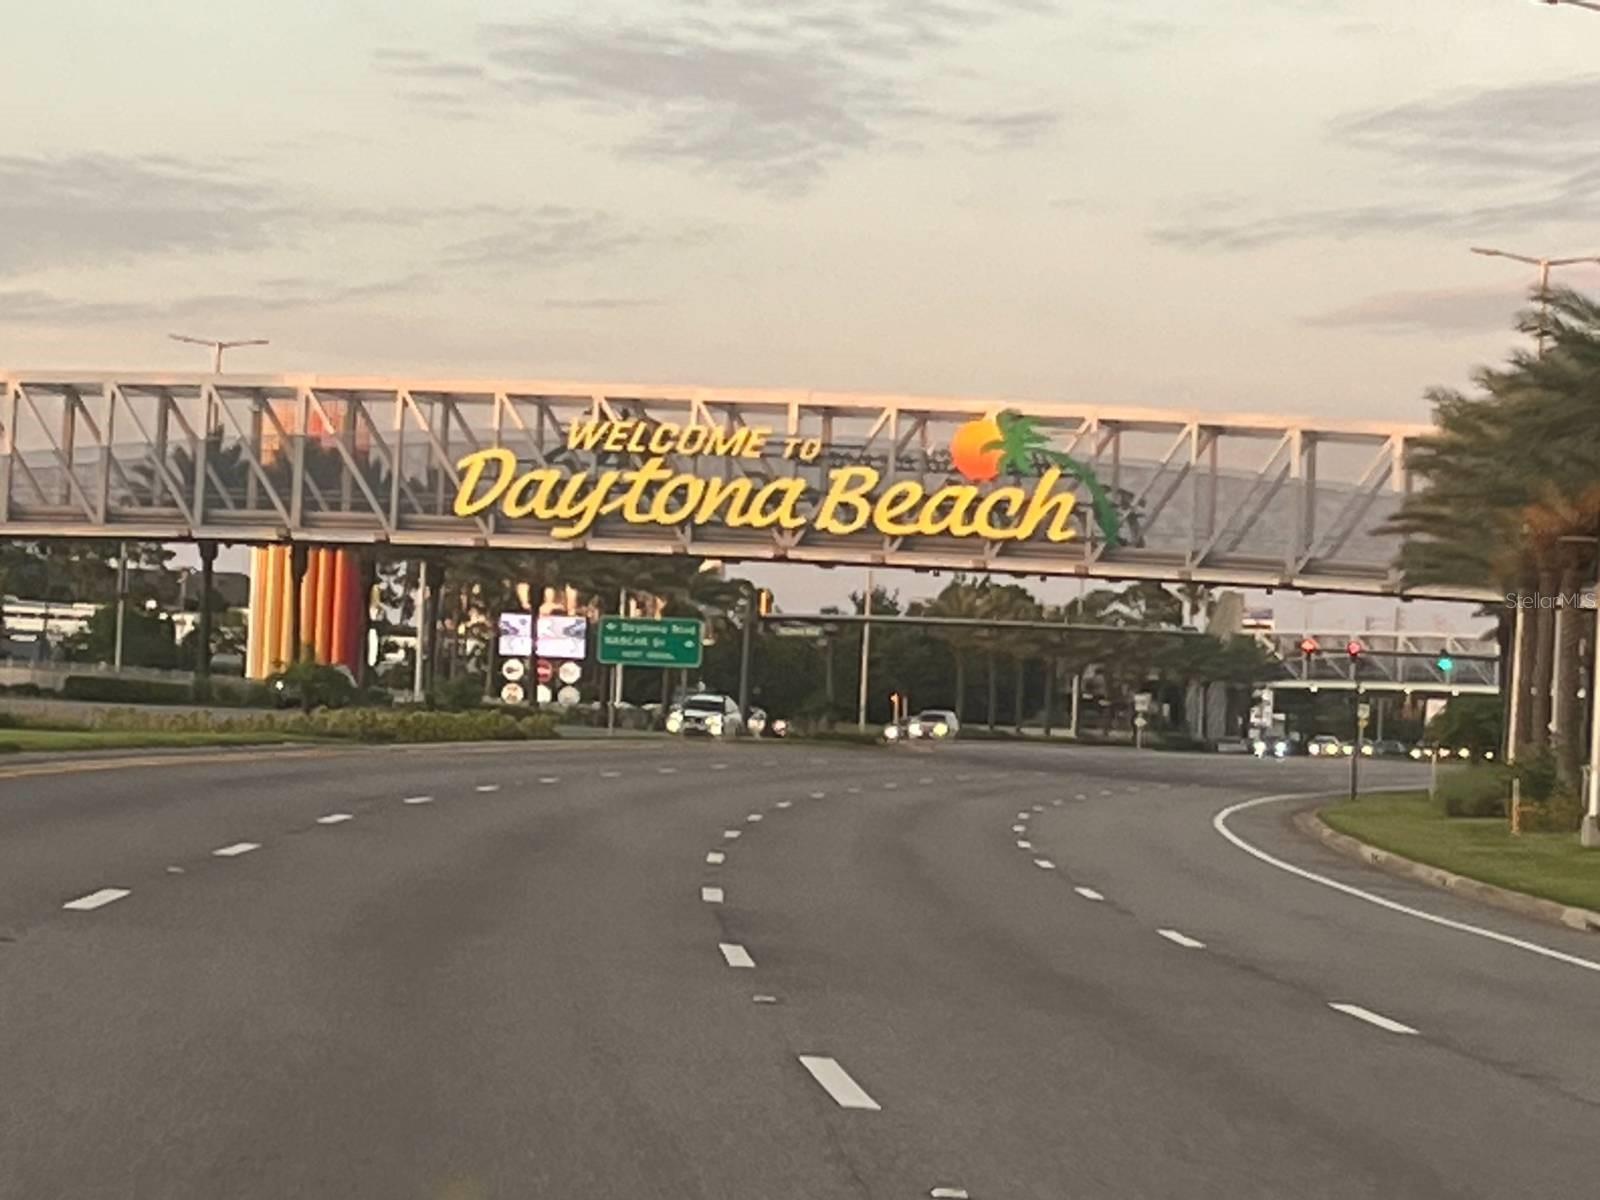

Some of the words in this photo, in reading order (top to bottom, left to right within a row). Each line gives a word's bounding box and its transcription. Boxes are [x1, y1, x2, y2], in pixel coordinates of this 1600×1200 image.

[567, 417, 773, 459] WELCOME
[783, 437, 822, 462] TO
[453, 447, 806, 539] Daytona
[814, 464, 1077, 542] Beach
